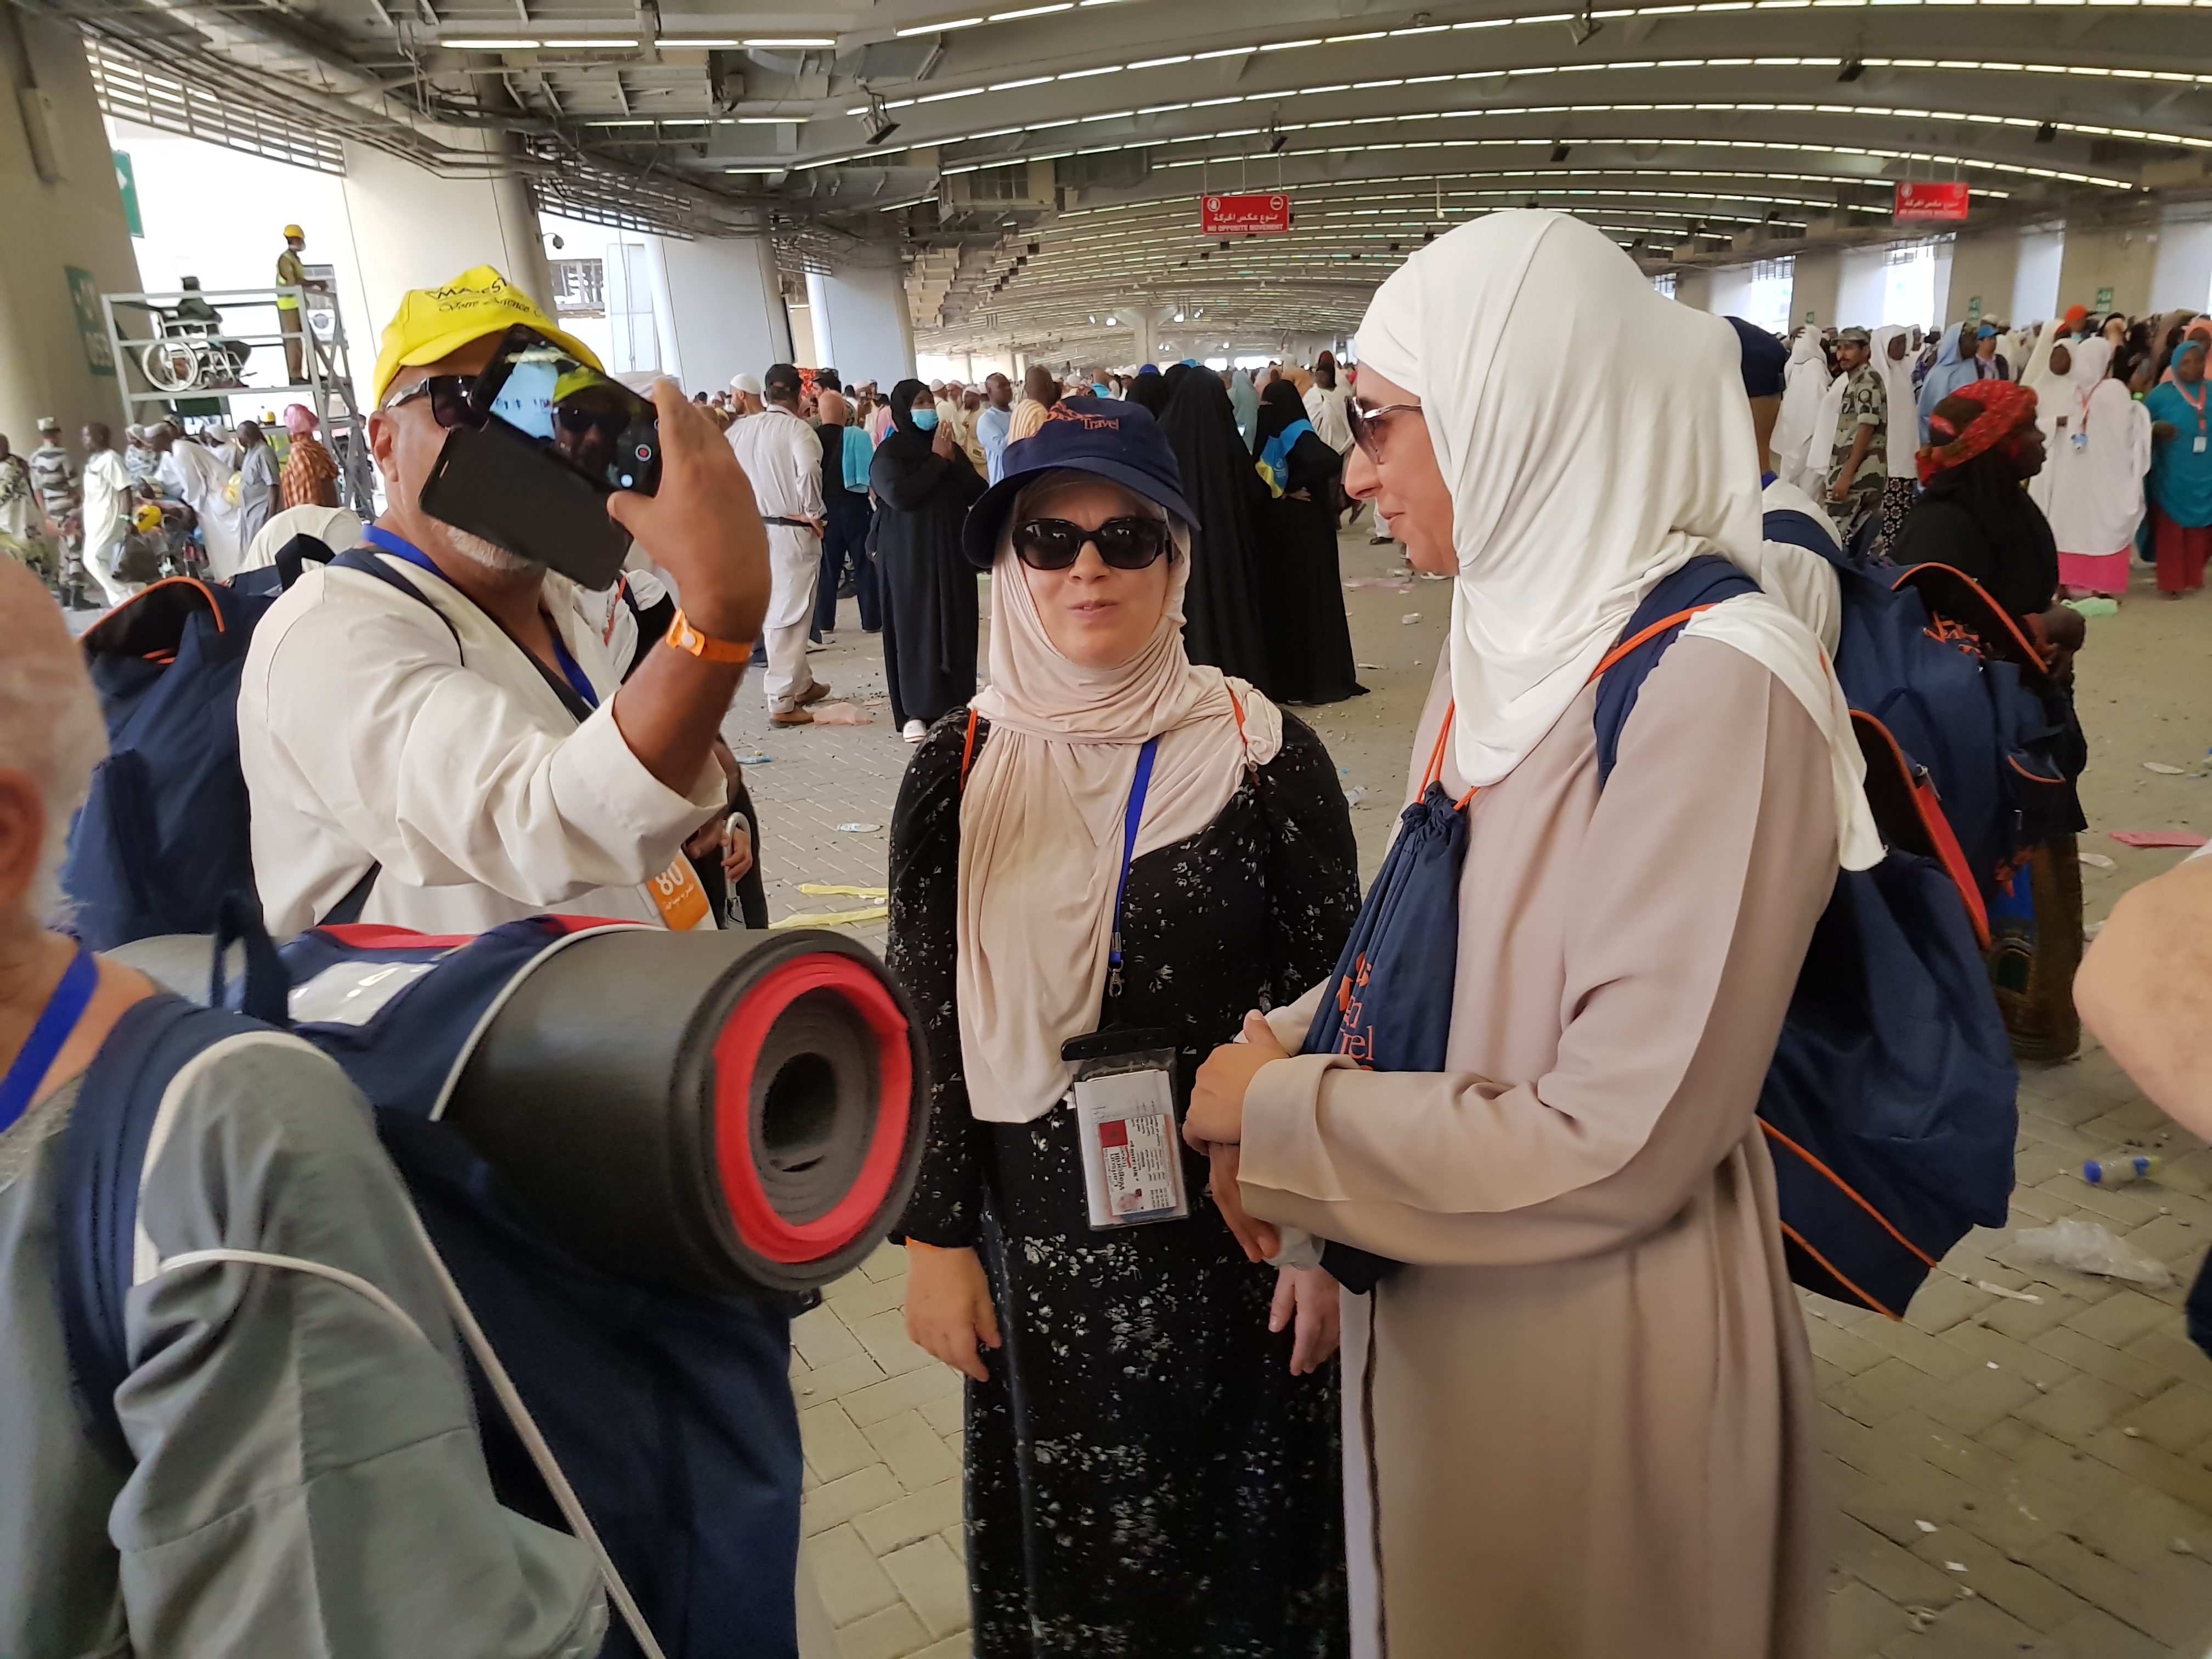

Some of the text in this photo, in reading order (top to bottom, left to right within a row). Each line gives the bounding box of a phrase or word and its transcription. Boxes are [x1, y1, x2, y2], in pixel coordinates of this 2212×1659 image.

[1080, 418, 1120, 430] Travel
[655, 861, 684, 895] 80
[1110, 1154, 1119, 1187] Carlson
[1114, 1153, 1125, 1190] Wagonlit
